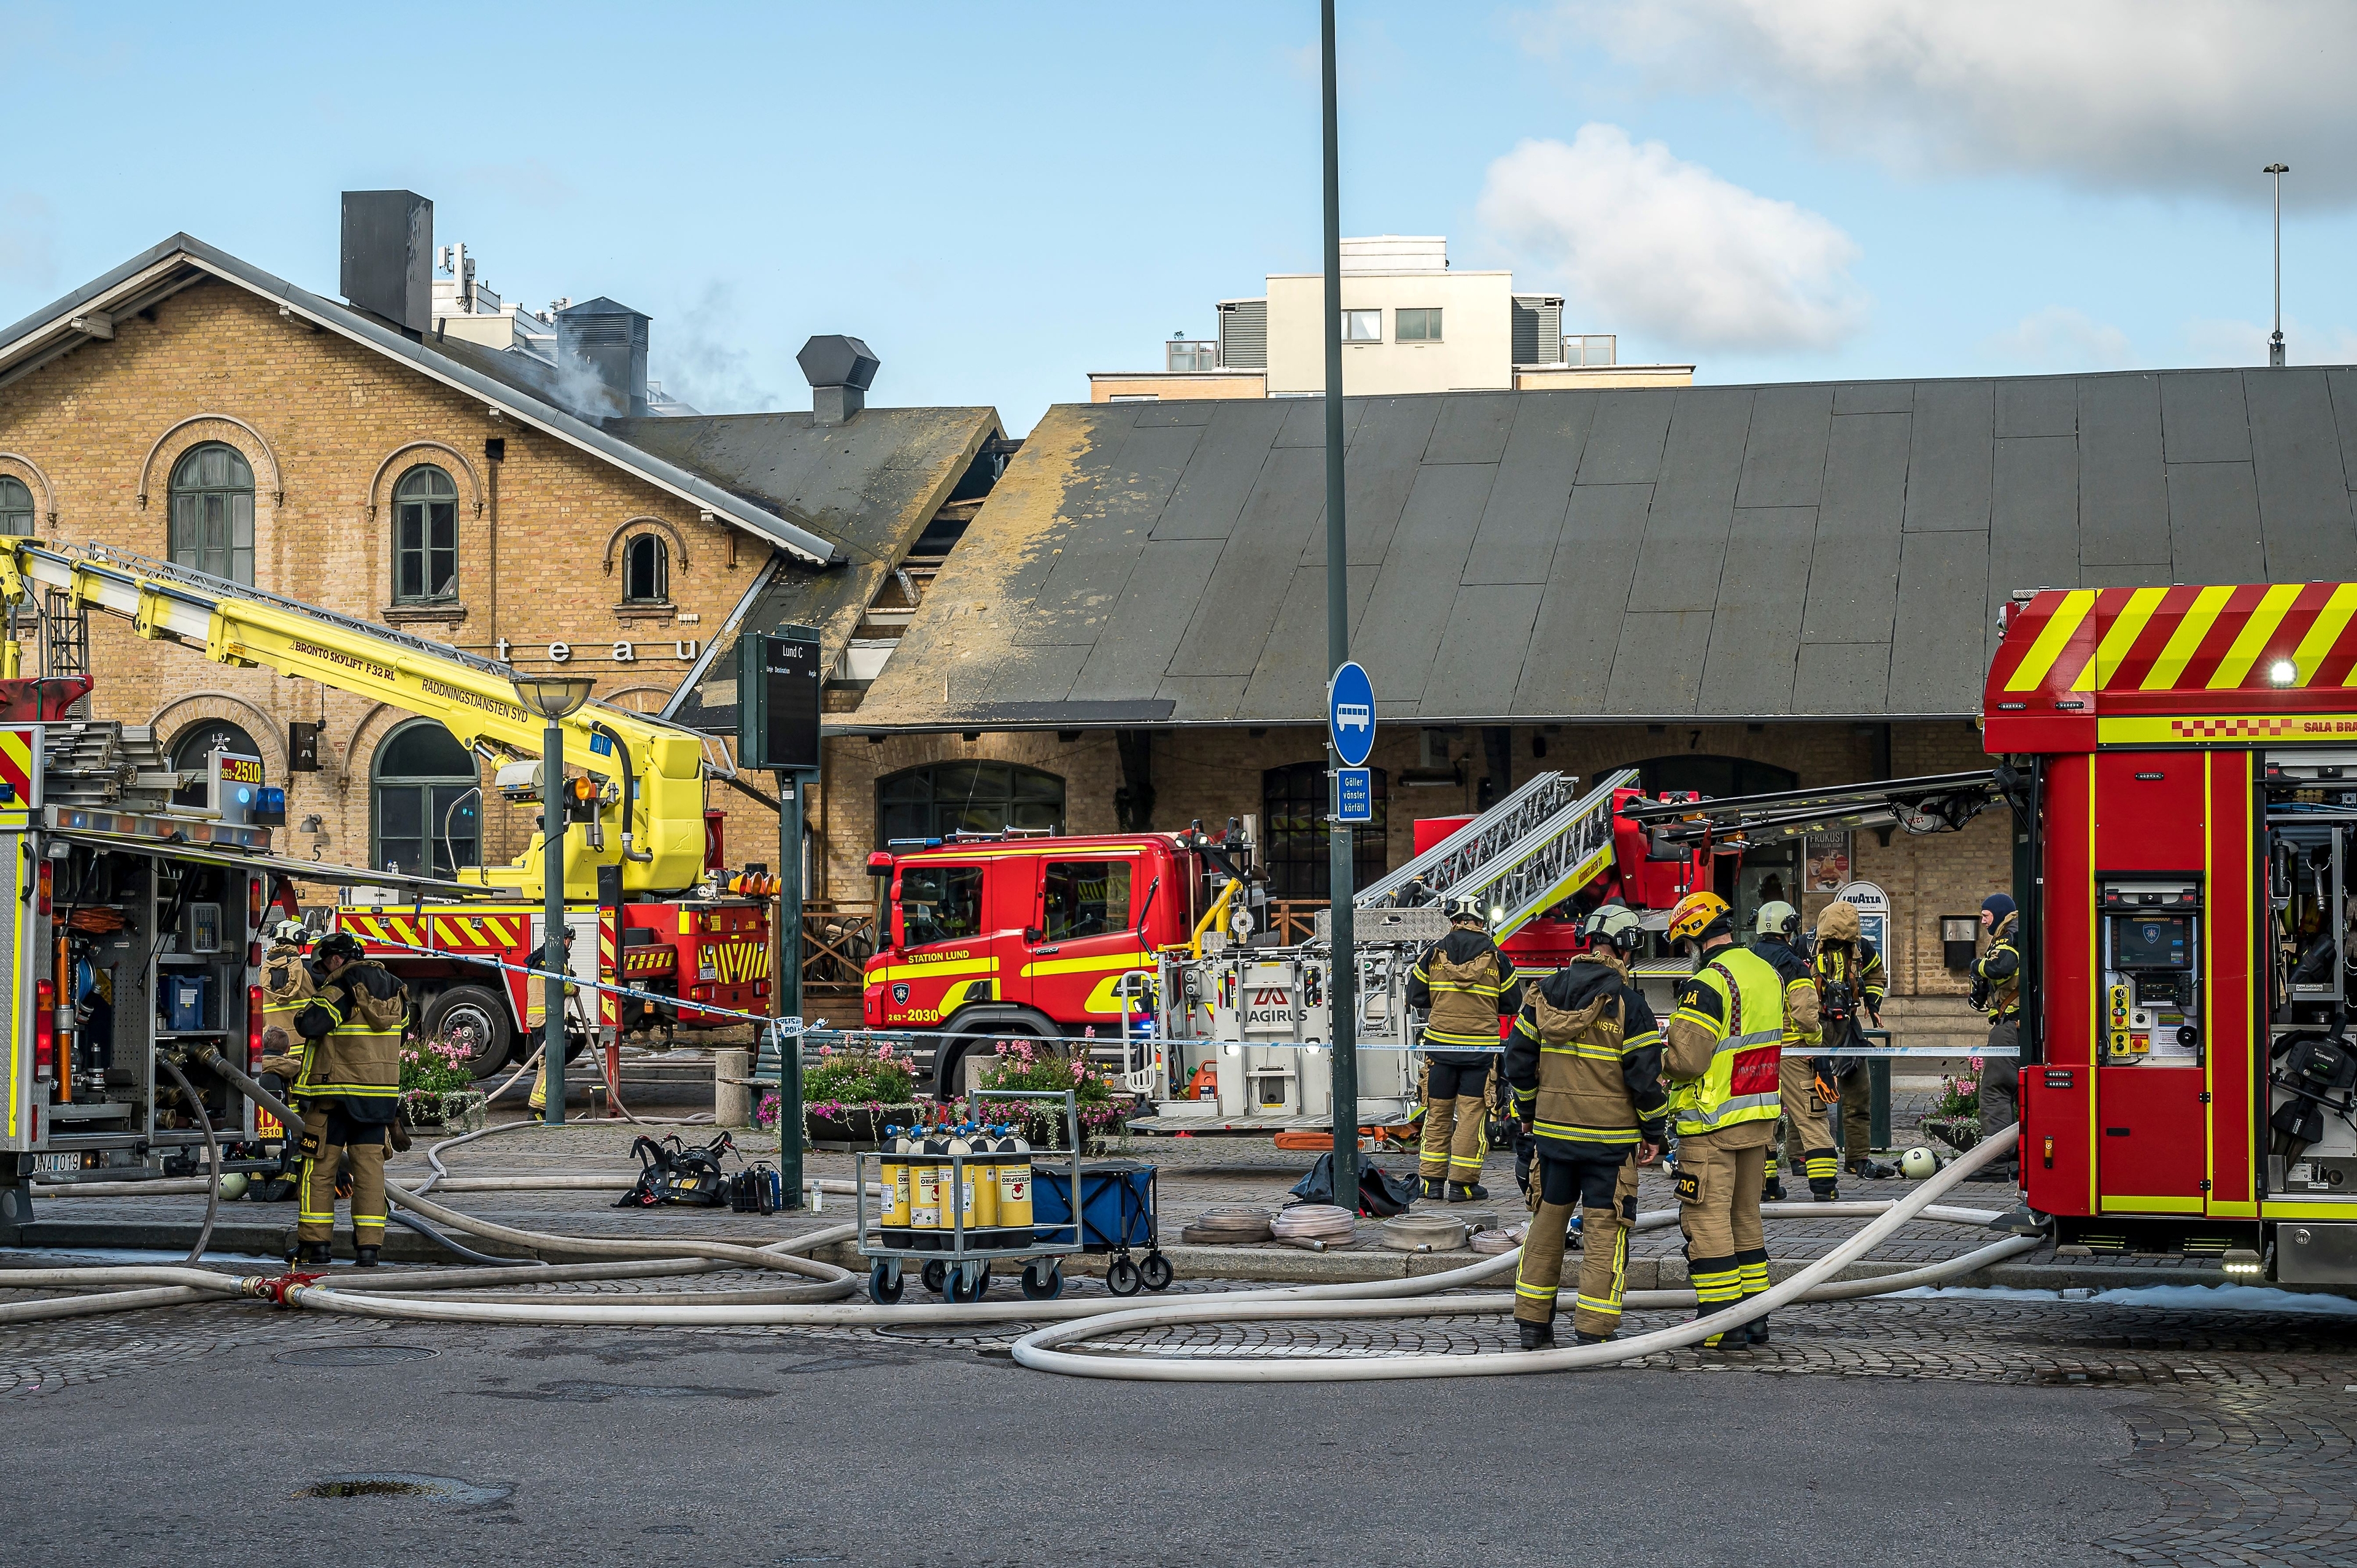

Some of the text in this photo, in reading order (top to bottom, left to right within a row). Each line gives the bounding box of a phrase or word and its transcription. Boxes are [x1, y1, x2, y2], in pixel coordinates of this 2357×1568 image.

[444, 638, 696, 662] teau
[783, 644, 803, 658] Lund C
[295, 641, 329, 660] BRONTO
[330, 652, 363, 670] SKYLIFT
[365, 663, 371, 673] F
[384, 668, 395, 681] RL
[422, 678, 528, 723] RÄDDNINGSTJÄNSTEN SYD
[2304, 722, 2332, 732] SALA
[221, 760, 260, 782] 263-2510
[1345, 778, 1363, 786] Gäller
[1343, 790, 1366, 799] vänster
[1344, 803, 1364, 812] körfält
[1810, 832, 1844, 843] FRUKOST
[312, 844, 322, 862] 5
[1843, 893, 1881, 903] LAVAZZA
[1672, 904, 1687, 921] NOC
[908, 949, 970, 964] STATION LUND
[1684, 990, 1699, 1005] JÄ
[2315, 1052, 2334, 1063] holmatro
[301, 1138, 317, 1148] 260
[60, 1154, 79, 1170] 019
